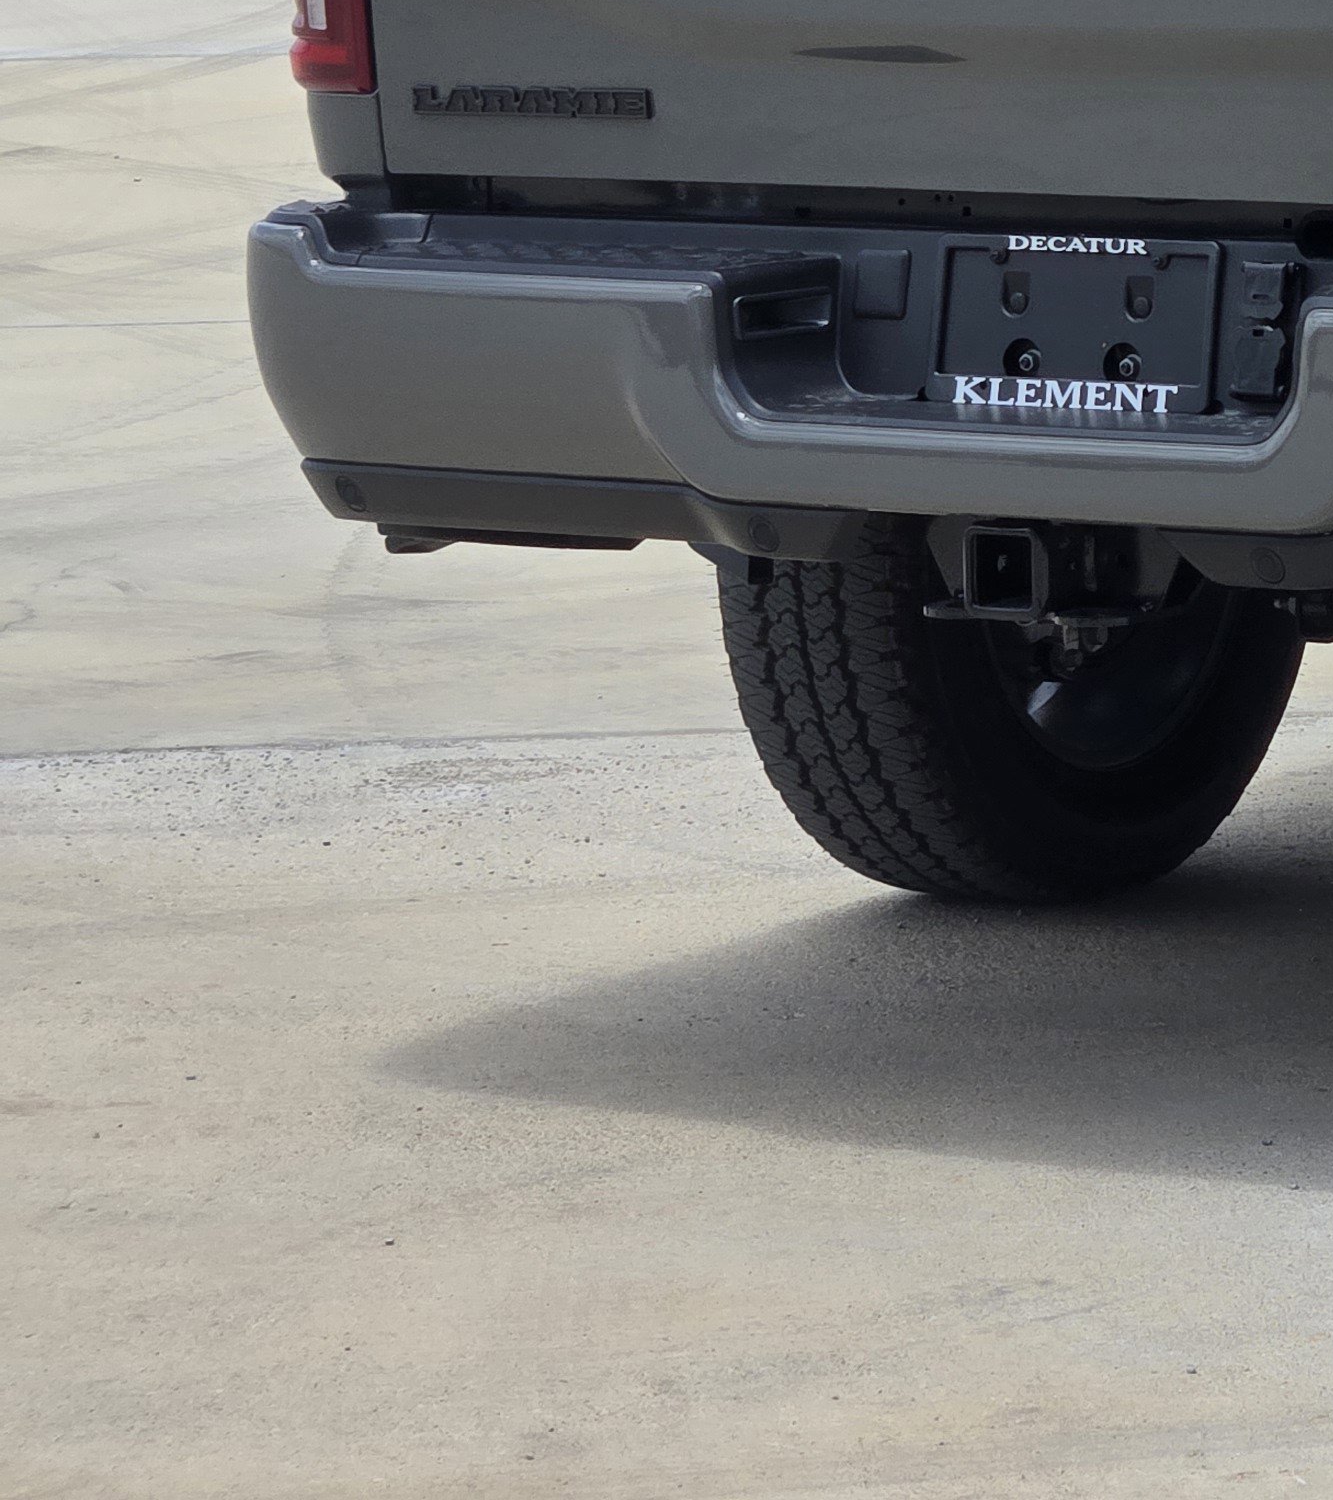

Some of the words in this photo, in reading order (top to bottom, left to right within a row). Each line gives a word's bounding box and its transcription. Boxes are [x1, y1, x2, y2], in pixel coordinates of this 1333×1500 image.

[412, 83, 656, 119] LARAMIE
[1007, 234, 1148, 256] DECATUR
[951, 375, 1179, 414] KLEMENT
